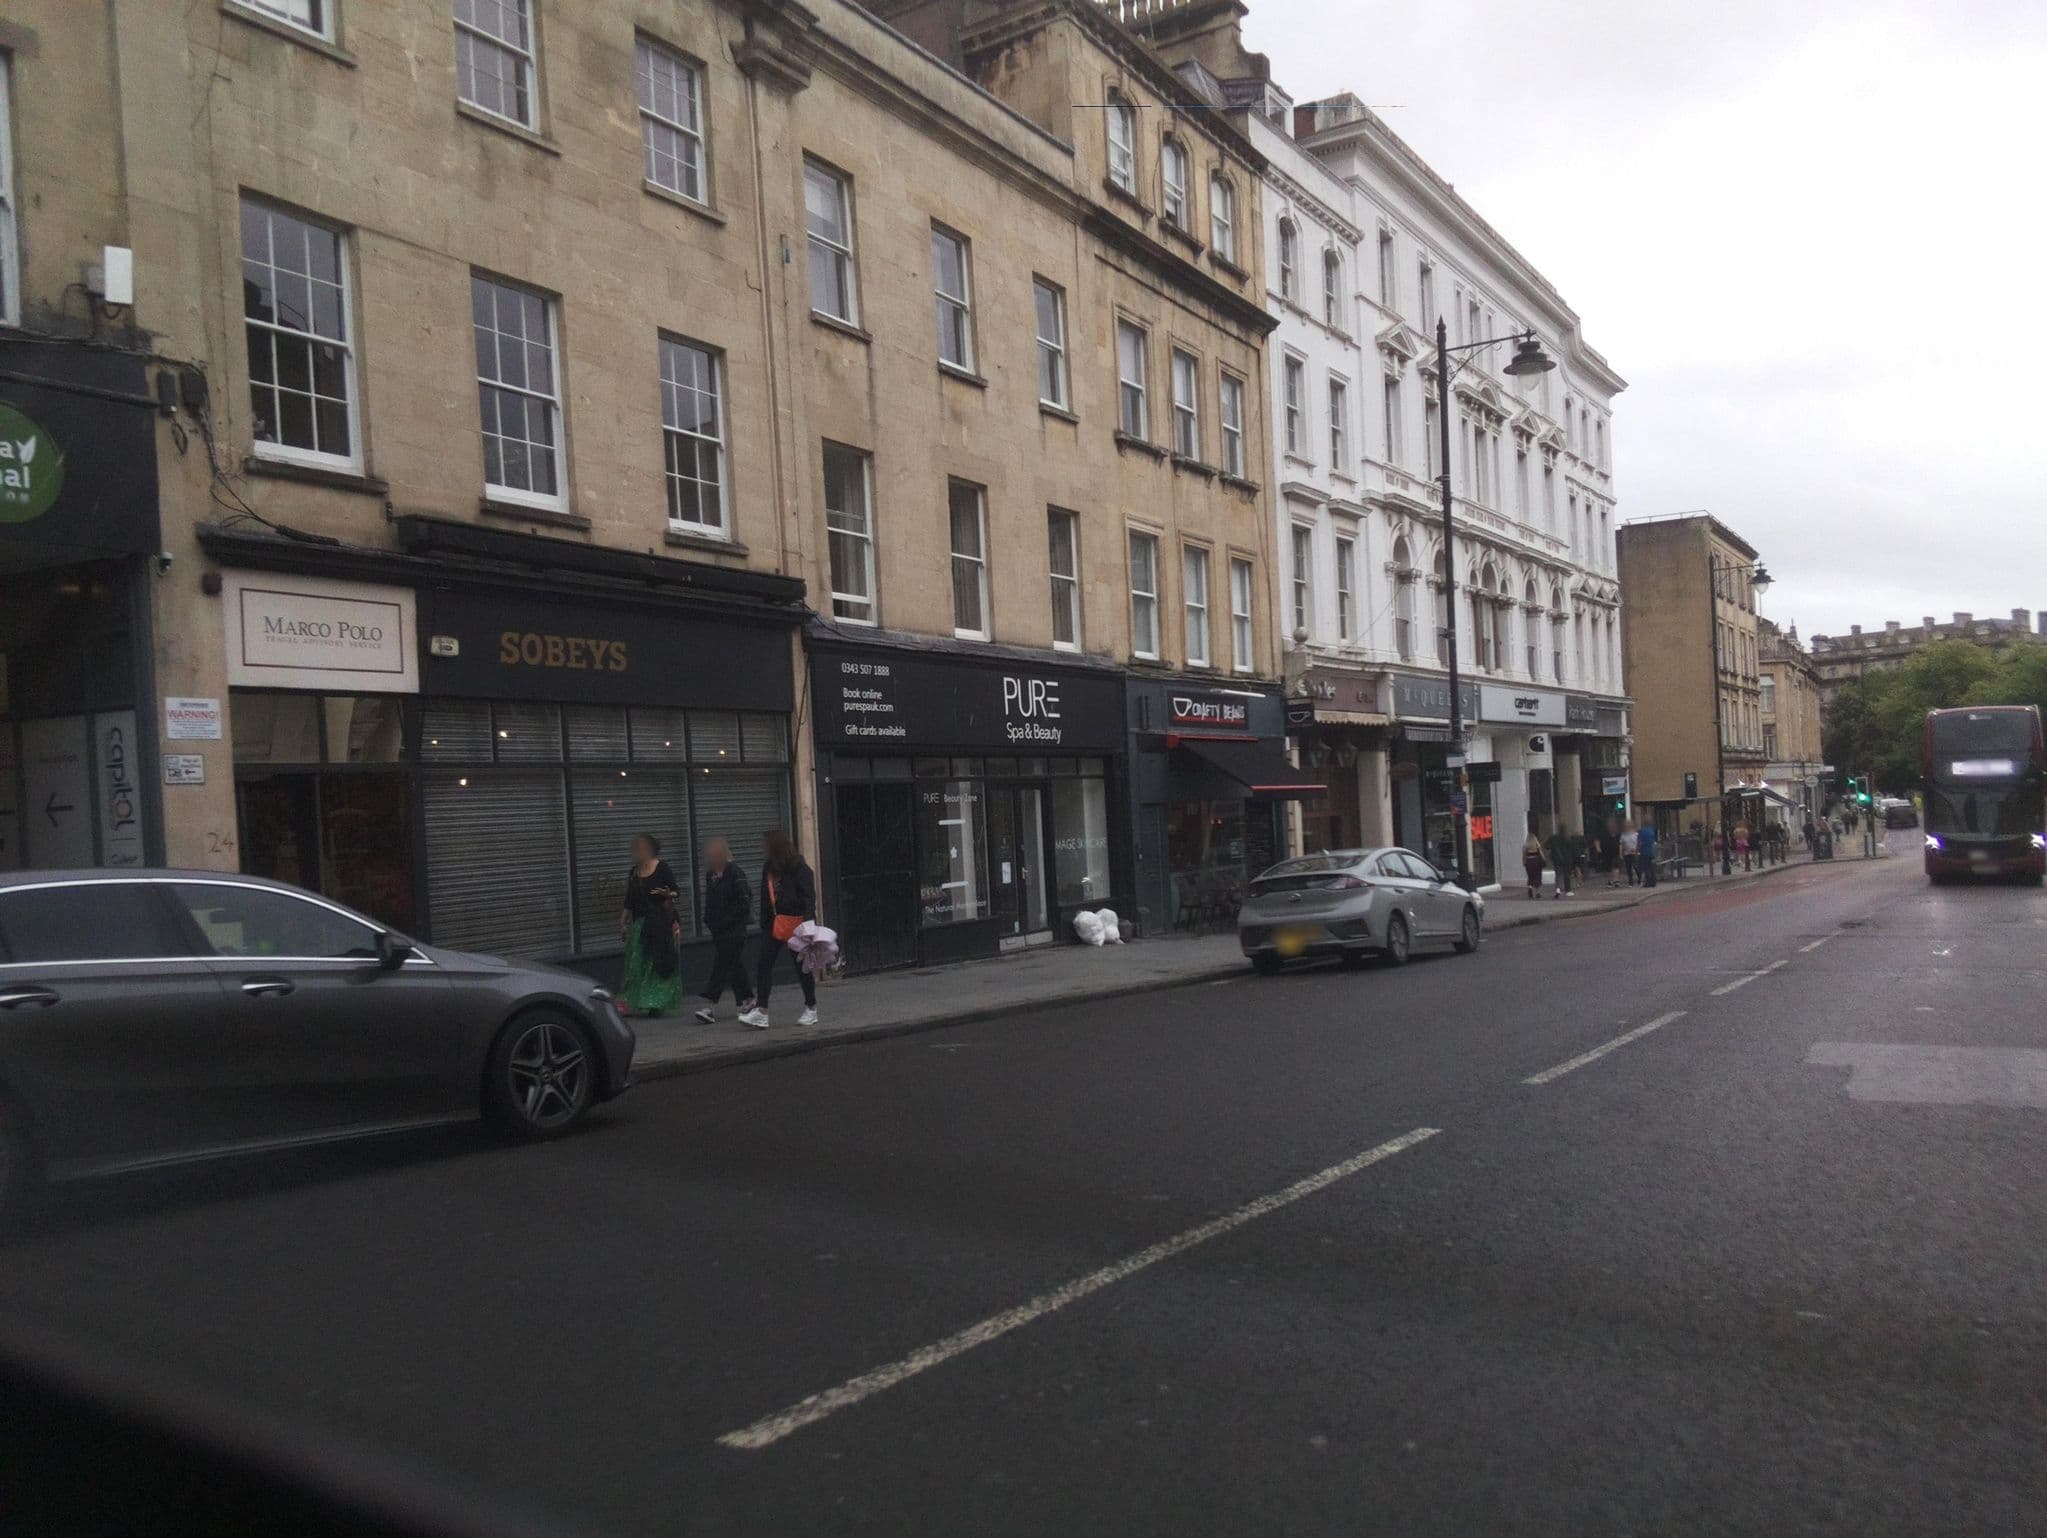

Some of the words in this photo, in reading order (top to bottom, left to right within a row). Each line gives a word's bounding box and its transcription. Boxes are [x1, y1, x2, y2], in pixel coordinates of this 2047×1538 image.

[263, 615, 332, 638] MARCO
[337, 621, 383, 642] POLO
[499, 631, 627, 671] SOBEYS
[841, 662, 859, 674] 0343
[860, 664, 873, 675] 507
[873, 665, 890, 676] 1888
[843, 687, 861, 699] Book
[861, 688, 883, 700] online
[1003, 676, 1061, 718] PURE
[844, 701, 894, 713] purespauk.com
[167, 709, 219, 720] WARNING!
[845, 724, 859, 736] Gift
[859, 725, 878, 736] cards
[878, 725, 907, 737] available
[1006, 721, 1024, 744] Spa
[1025, 722, 1033, 740] &
[1033, 723, 1062, 745] Beauty
